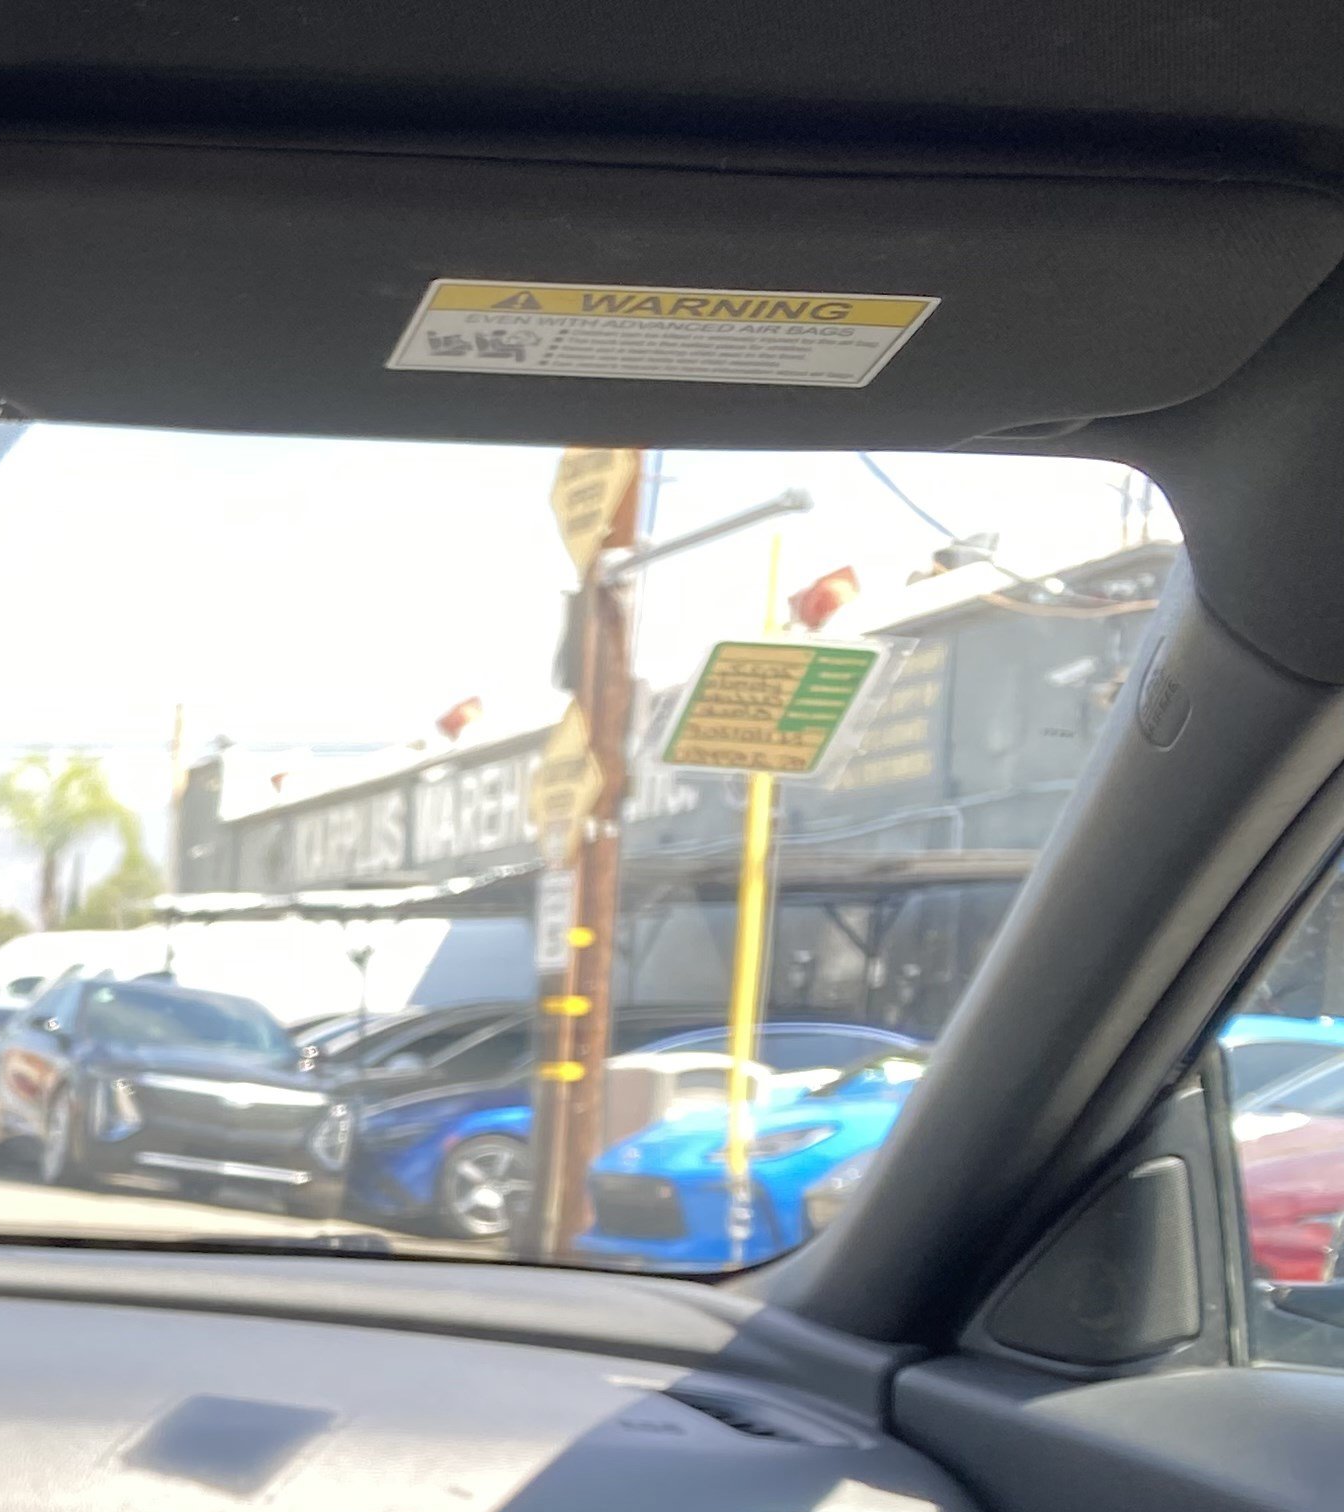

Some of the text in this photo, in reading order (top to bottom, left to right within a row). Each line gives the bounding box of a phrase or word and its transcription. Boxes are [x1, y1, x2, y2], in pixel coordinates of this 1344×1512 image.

[581, 293, 854, 321] WARNING
[464, 314, 856, 338] EVEN WITH ADVANCED AIR BAGS
